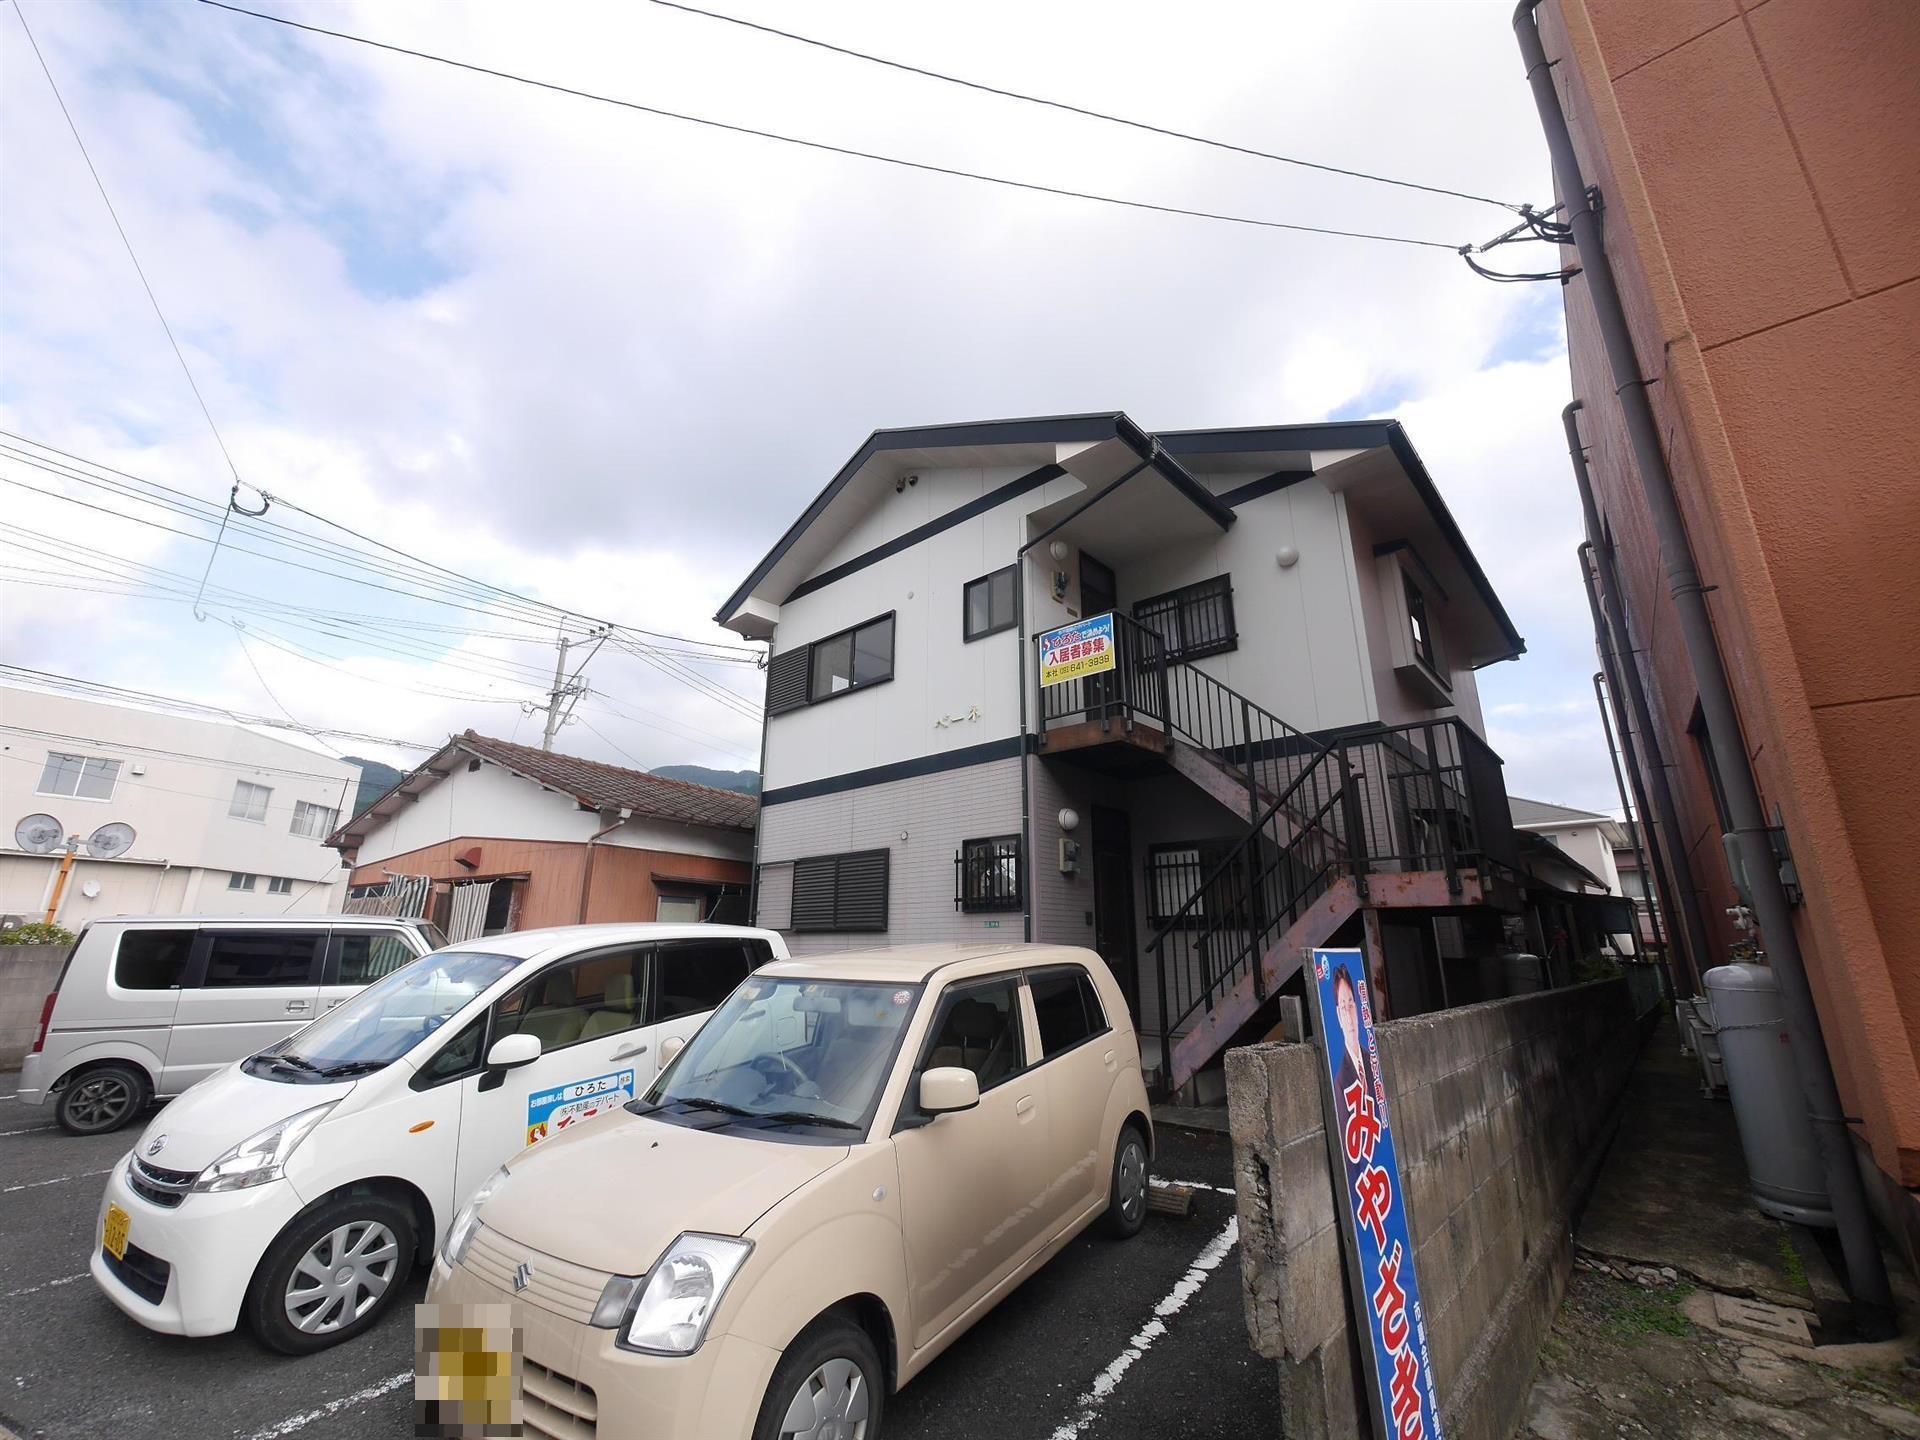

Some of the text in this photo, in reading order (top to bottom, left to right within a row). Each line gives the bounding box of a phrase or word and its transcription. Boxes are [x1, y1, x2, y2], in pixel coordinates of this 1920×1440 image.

[1048, 637, 1105, 666] 入居者募集
[574, 1080, 607, 1097] ひろた
[1344, 1079, 1424, 1440] みやざき
